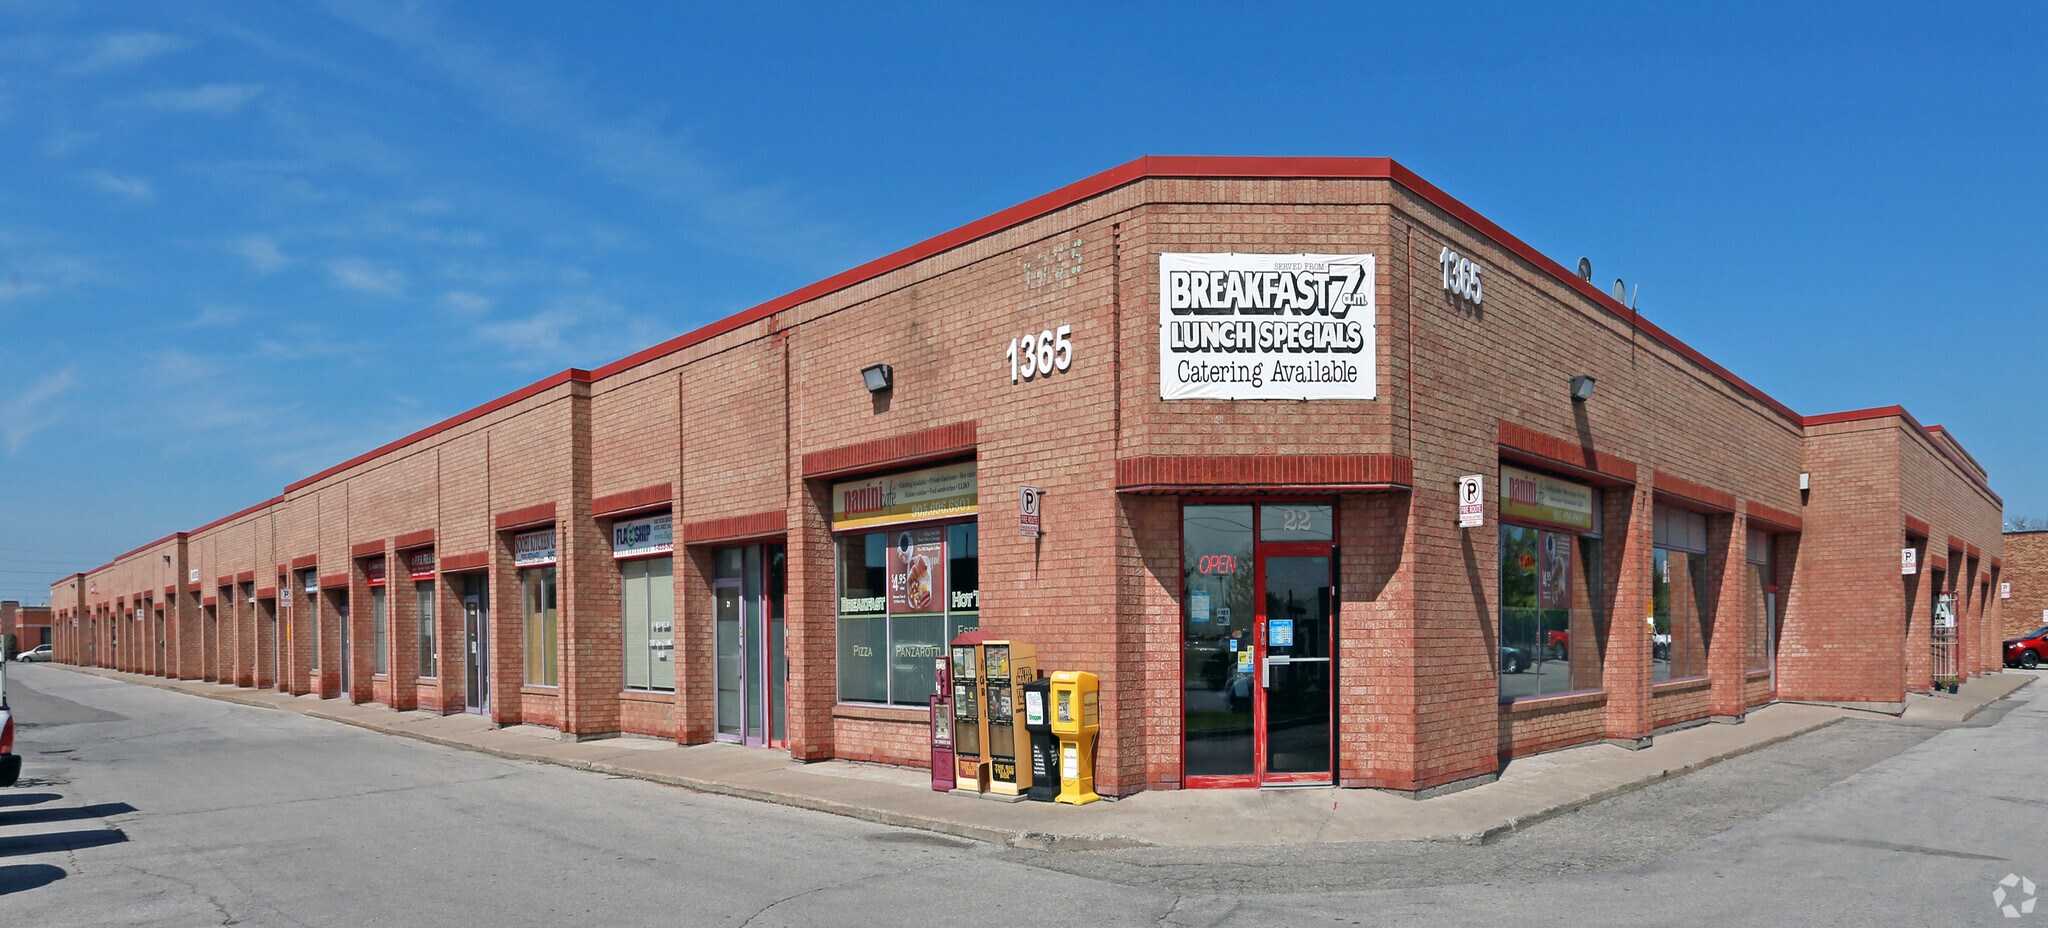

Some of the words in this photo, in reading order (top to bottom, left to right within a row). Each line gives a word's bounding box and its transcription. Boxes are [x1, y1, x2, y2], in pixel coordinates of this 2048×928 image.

[1274, 263, 1302, 271] SERVED
[1304, 263, 1327, 271] FROM:
[1440, 246, 1482, 305] 1365
[1170, 270, 1330, 316] BREAKFAST
[1328, 264, 1366, 319] 7
[1170, 321, 1256, 353] LUNCH
[1258, 321, 1364, 353] SPECIALS
[1006, 324, 1073, 385] 1365
[1178, 359, 1263, 388] Catering
[1270, 359, 1358, 383] Available
[844, 481, 883, 519] panini
[1509, 476, 1536, 507] panini
[1284, 509, 1311, 531] 22
[616, 523, 651, 547] FLAGSHIP
[1199, 555, 1237, 575] OPEN
[841, 597, 886, 612] BREAKFAST
[952, 592, 973, 608] HOT
[854, 645, 873, 657] PIZZA
[896, 645, 941, 658] PANZAROTTI
